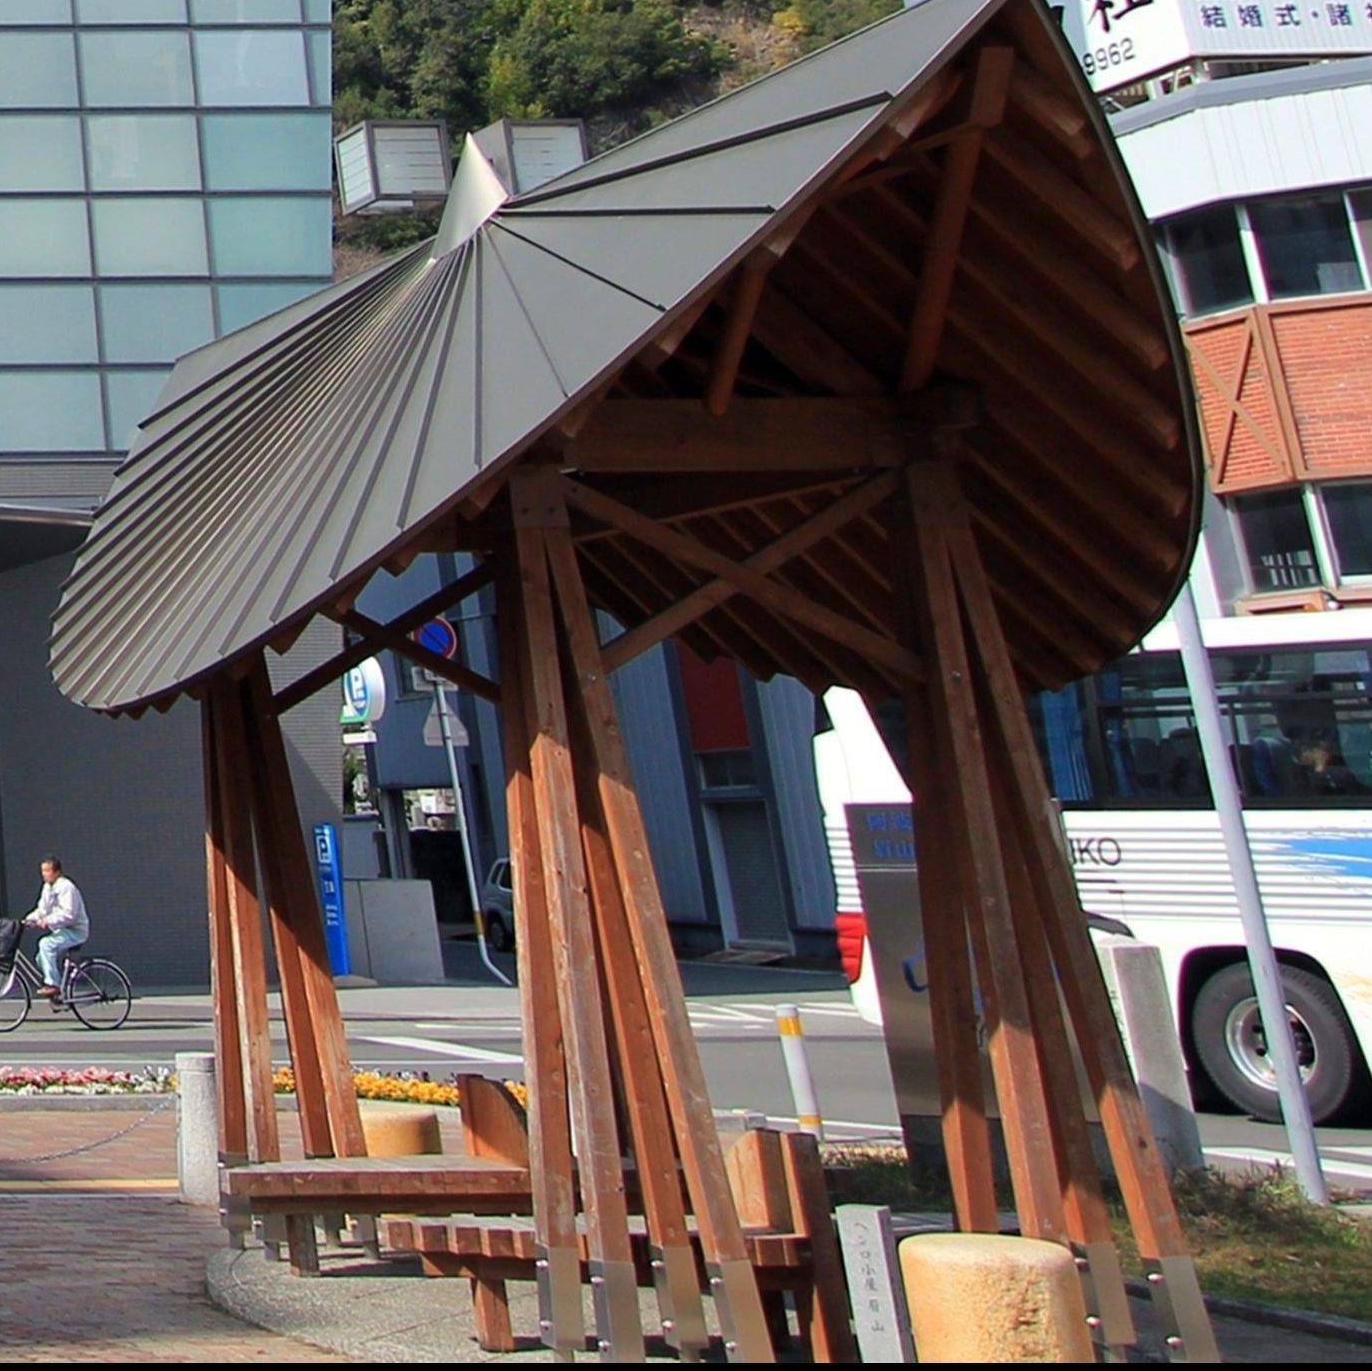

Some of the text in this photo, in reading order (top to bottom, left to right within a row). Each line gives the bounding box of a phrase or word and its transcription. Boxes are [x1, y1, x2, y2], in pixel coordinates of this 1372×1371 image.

[1200, 2, 1372, 28] 結婚式・諸
[1070, 837, 1122, 866] KO
